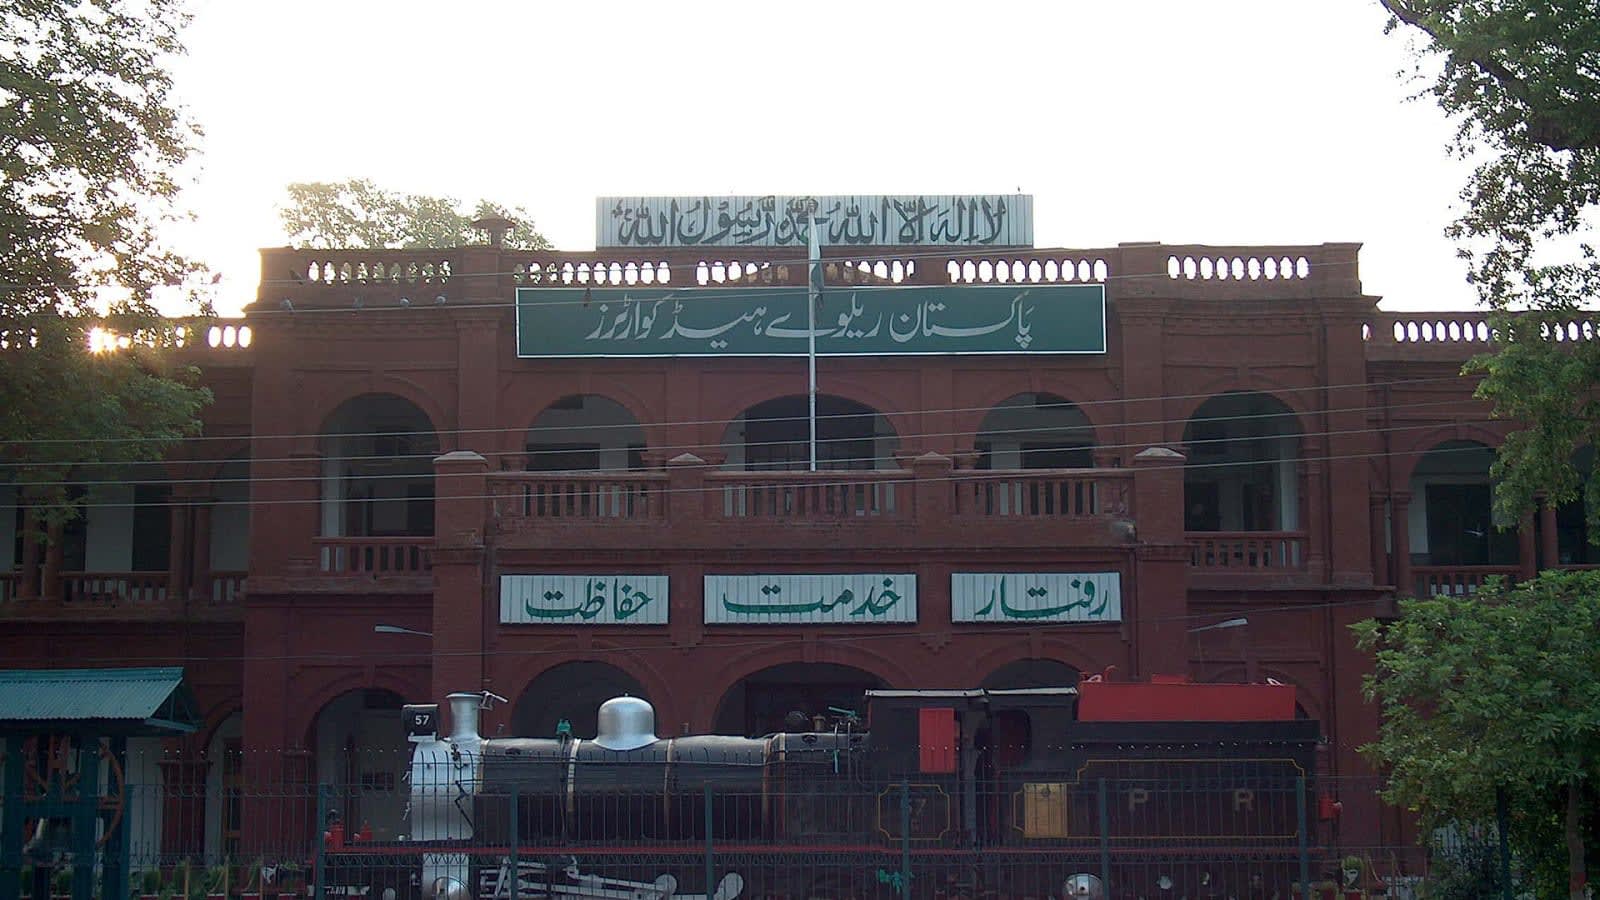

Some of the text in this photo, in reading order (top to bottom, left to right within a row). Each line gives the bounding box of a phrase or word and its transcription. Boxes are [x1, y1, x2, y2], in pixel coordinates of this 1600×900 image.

[659, 299, 767, 349] ہیڈ
[765, 292, 883, 338] ریلوے
[889, 290, 1035, 349] پاکستان
[526, 578, 653, 620] حفاظت
[723, 577, 902, 616] خدمت
[975, 576, 1108, 619] رفتار
[415, 714, 430, 725] 57
[1129, 788, 1254, 812] P R
